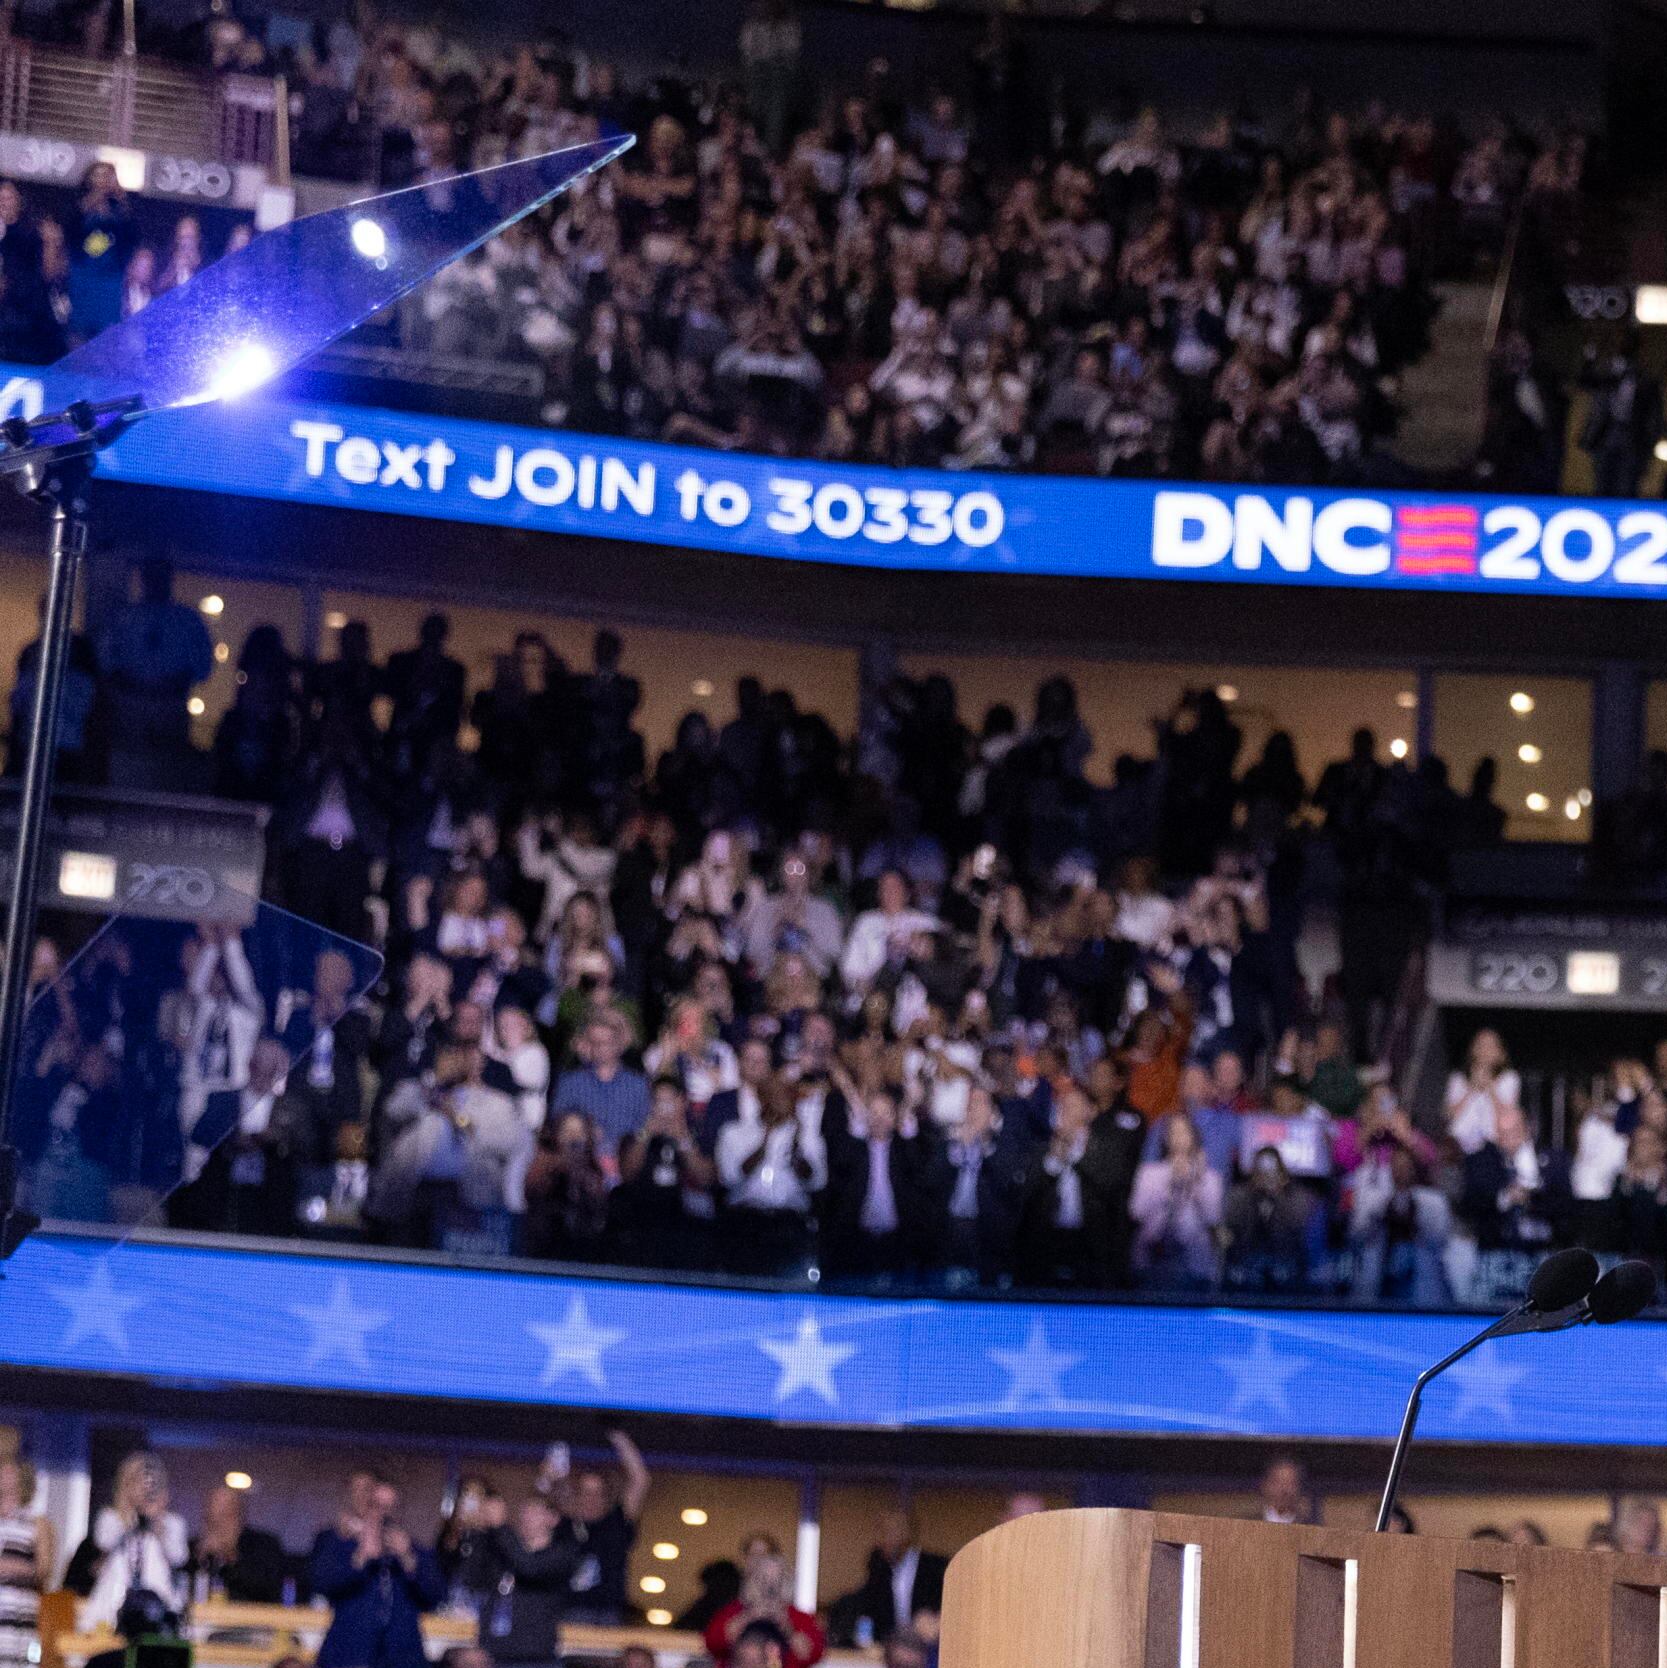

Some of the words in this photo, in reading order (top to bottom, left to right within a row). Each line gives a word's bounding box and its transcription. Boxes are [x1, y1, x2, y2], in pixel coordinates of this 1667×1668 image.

[289, 420, 456, 493] Text
[468, 445, 656, 516] JOIN
[674, 467, 751, 527] to
[765, 477, 1004, 548] 30330
[1152, 491, 1393, 577] DNC
[1475, 951, 1559, 992] 220
